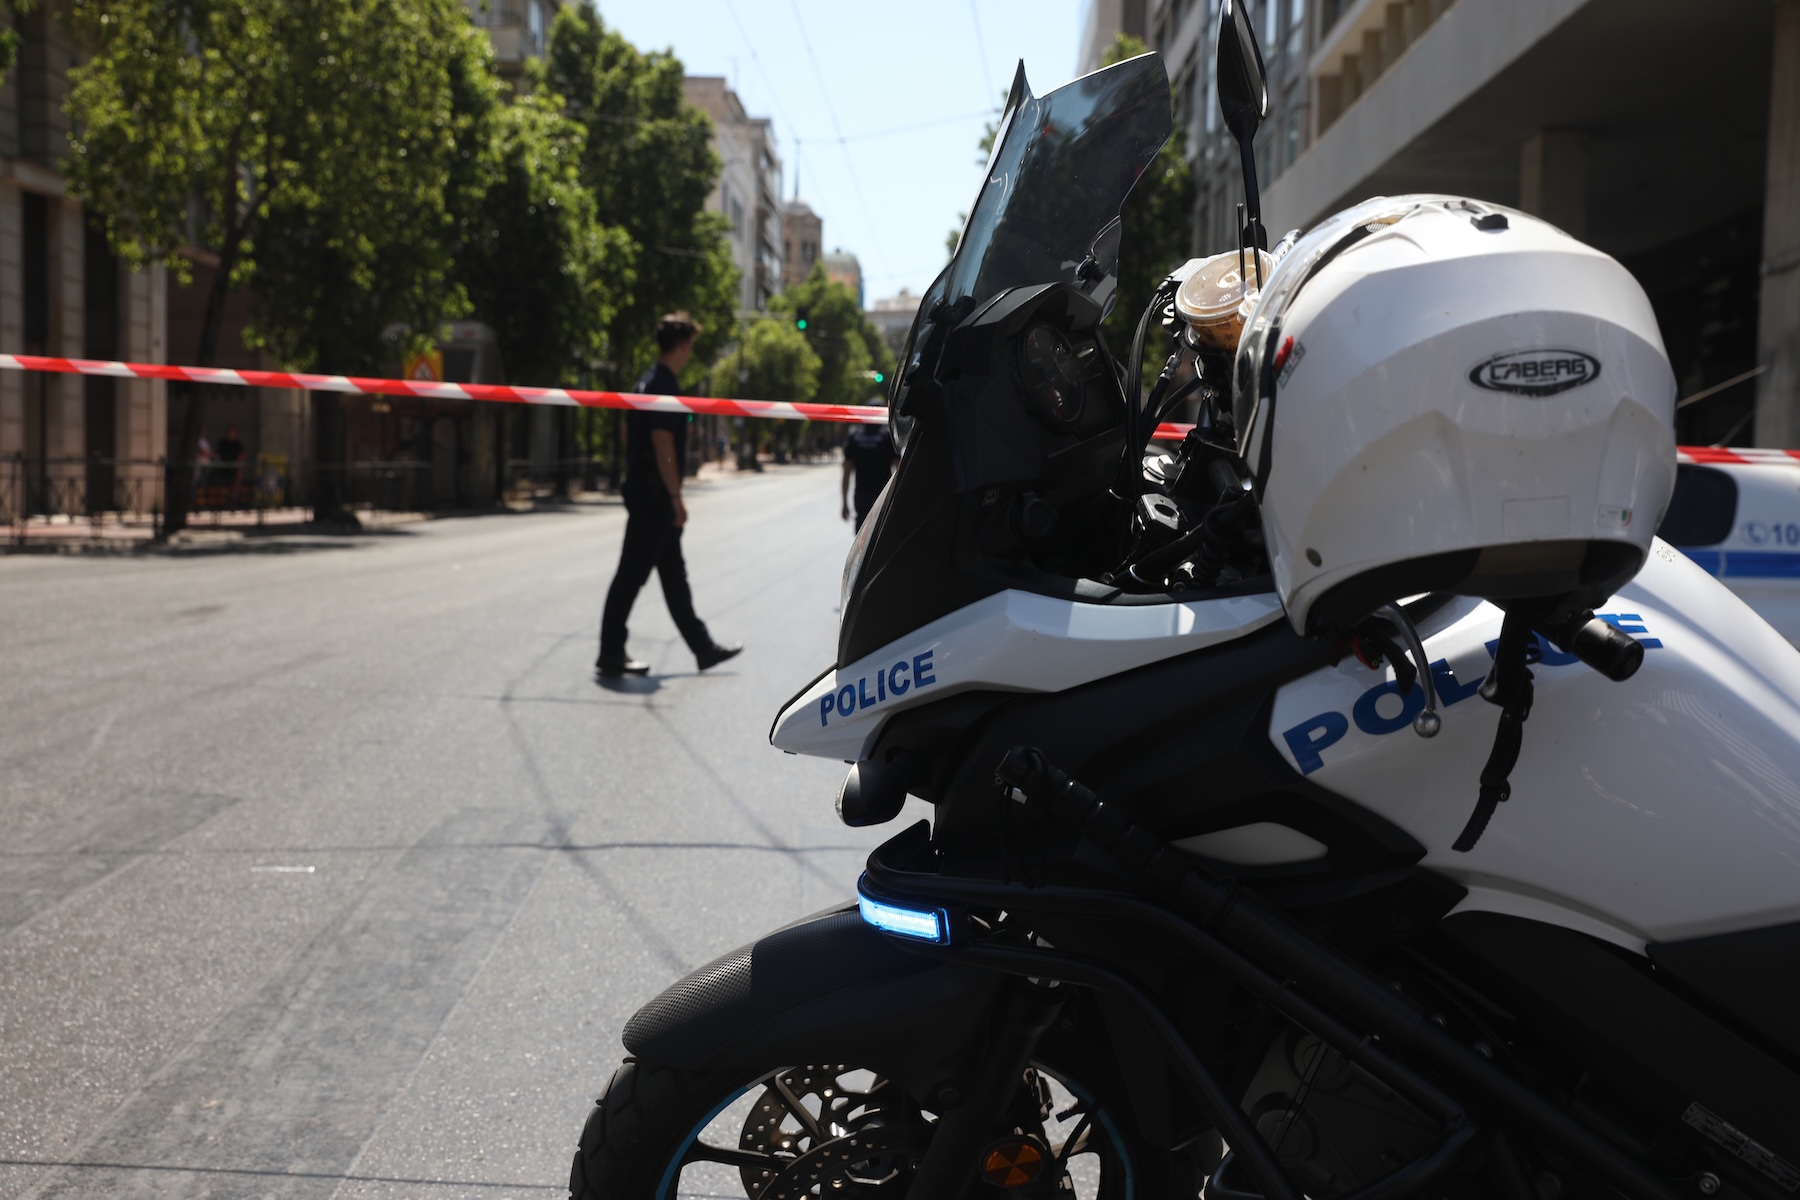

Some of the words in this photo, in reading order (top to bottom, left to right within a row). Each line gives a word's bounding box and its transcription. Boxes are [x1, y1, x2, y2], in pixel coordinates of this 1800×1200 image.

[1490, 359, 1587, 381] CABERG
[820, 649, 937, 727] POLICE
[1283, 613, 1664, 776] POLE
